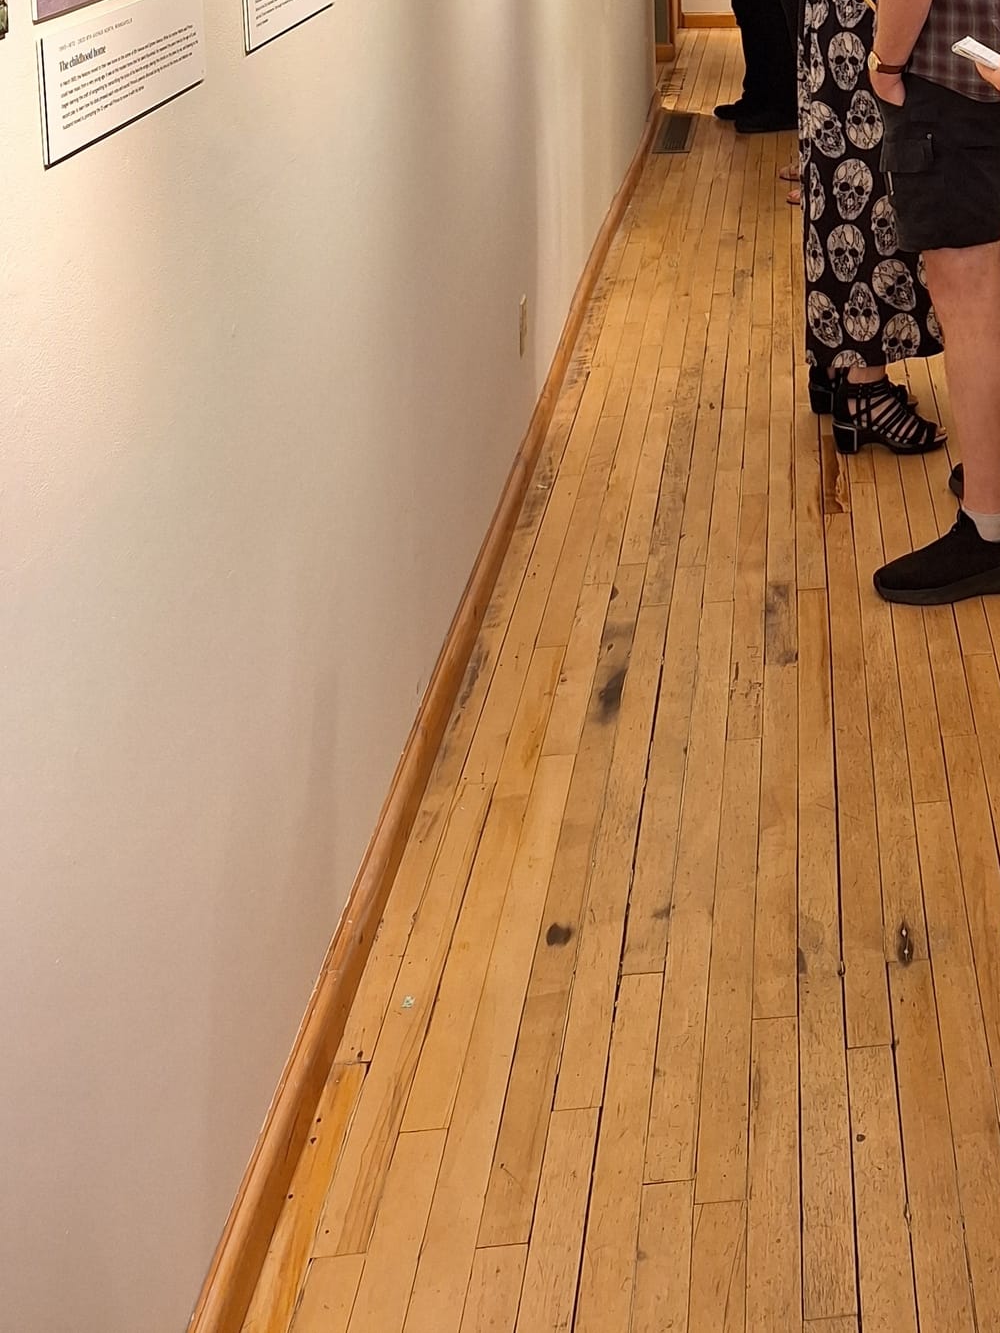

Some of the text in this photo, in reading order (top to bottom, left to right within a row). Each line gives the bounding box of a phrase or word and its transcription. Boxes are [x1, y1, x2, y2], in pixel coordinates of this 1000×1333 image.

[59, 45, 106, 72] The childhood home
